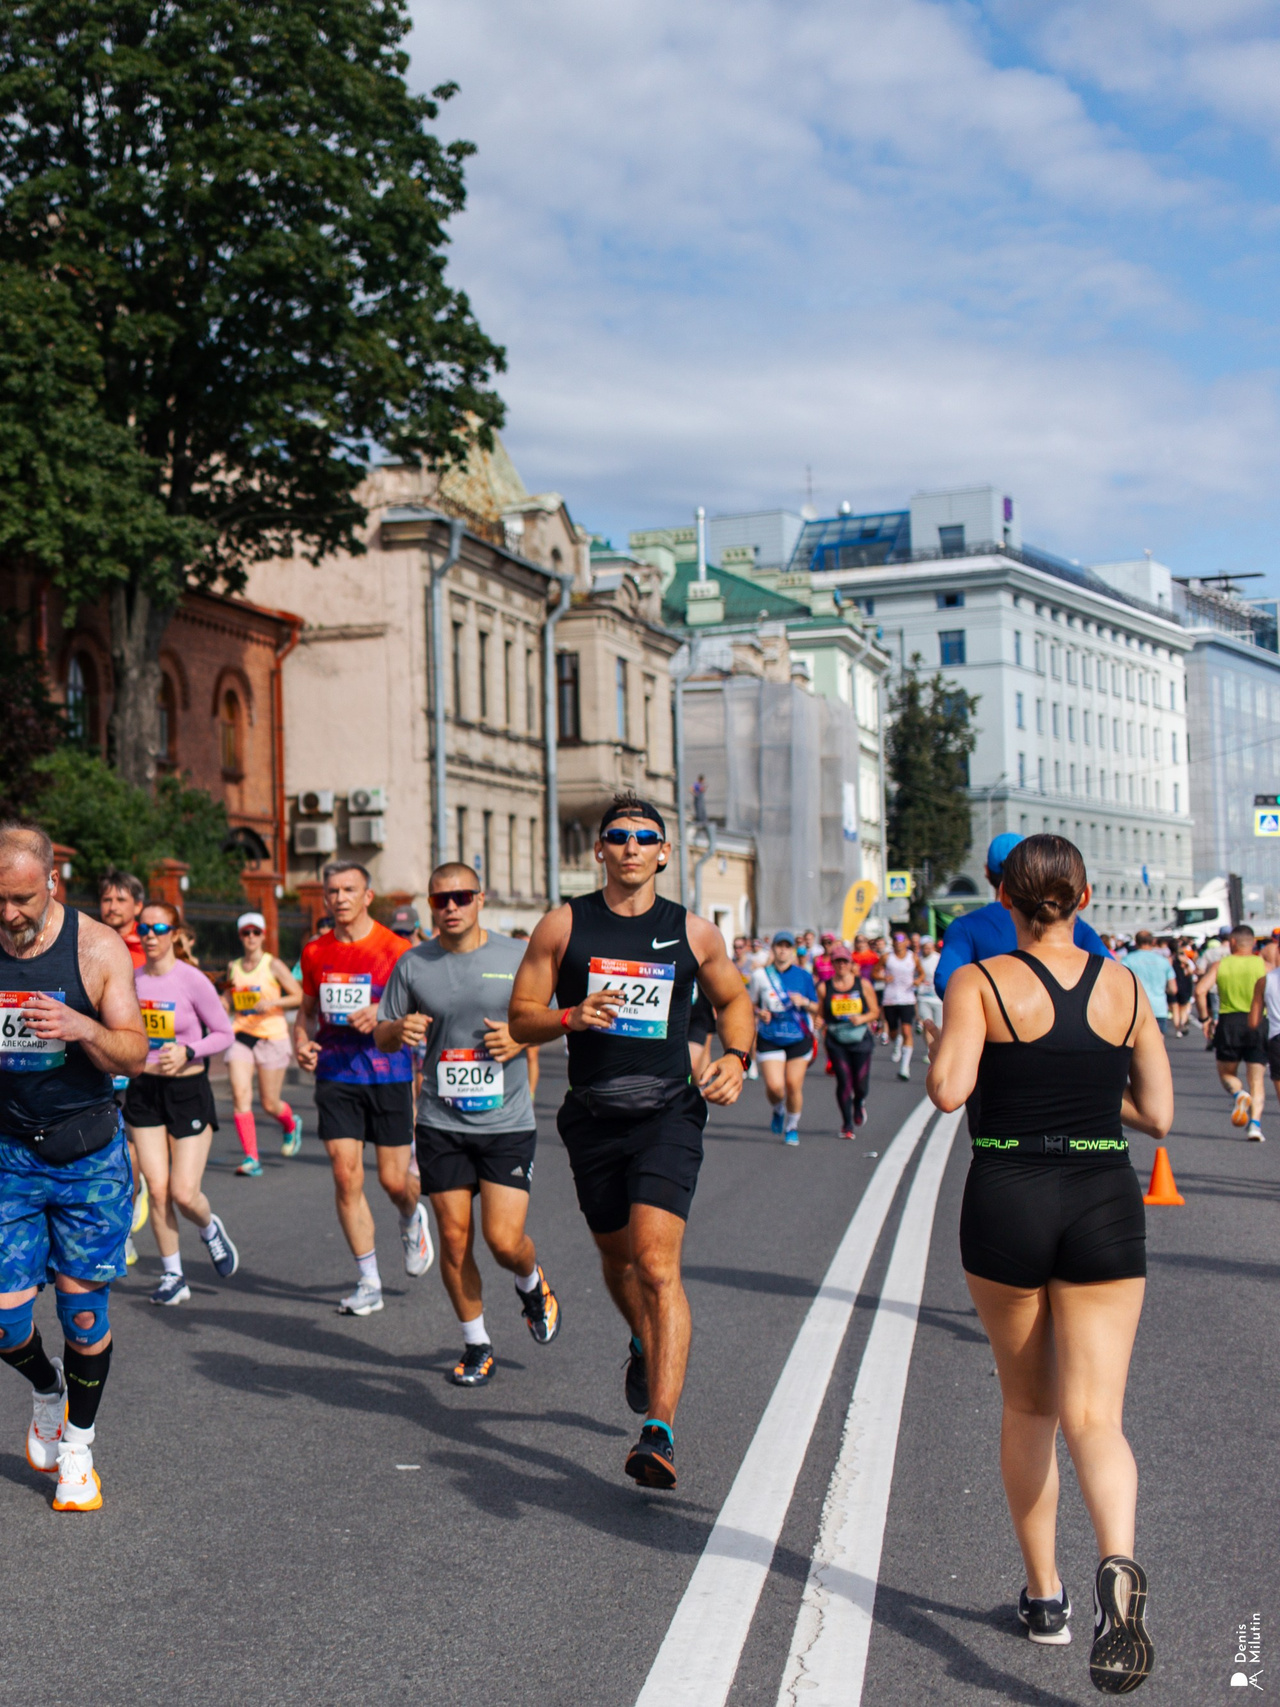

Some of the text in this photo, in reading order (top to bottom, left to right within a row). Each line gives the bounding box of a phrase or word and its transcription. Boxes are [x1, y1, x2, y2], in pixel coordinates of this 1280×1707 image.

[326, 988, 363, 1004] 3152
[1, 1040, 48, 1049] АЛЕКСАНДР
[446, 1066, 495, 1085] 5206
[972, 1137, 1020, 1149] WERUP
